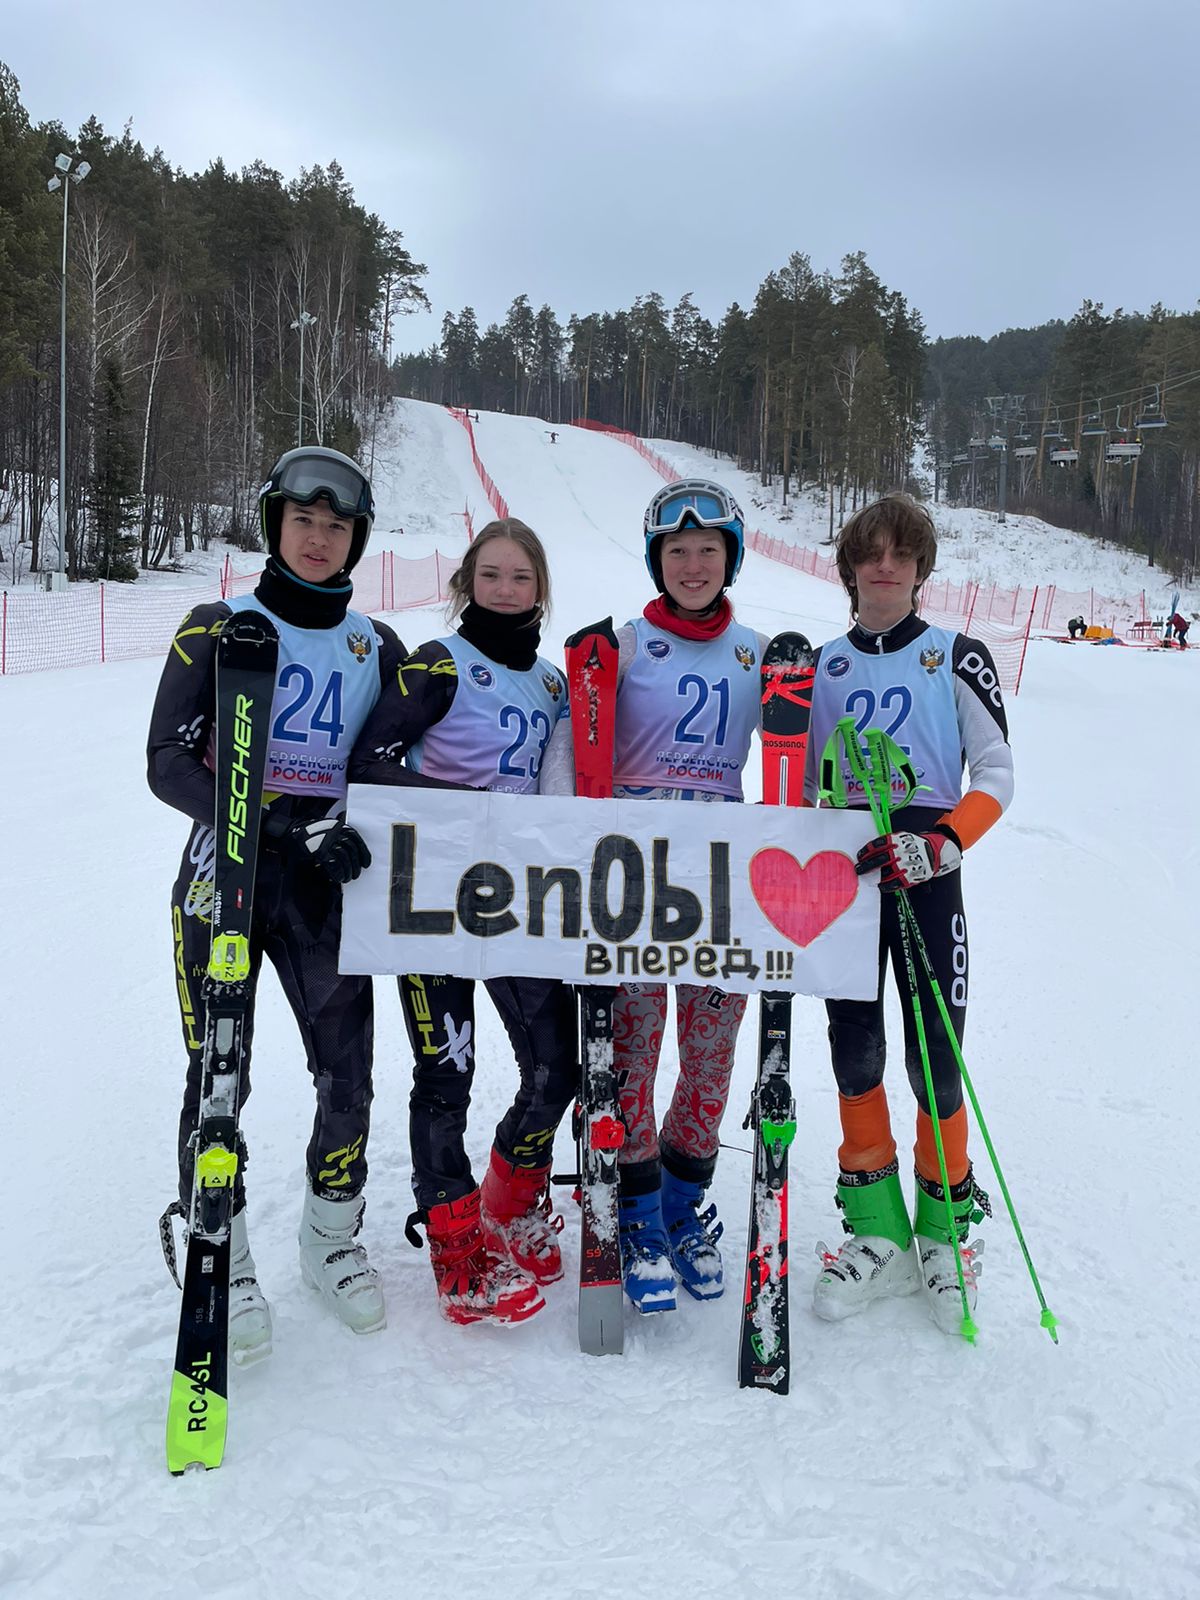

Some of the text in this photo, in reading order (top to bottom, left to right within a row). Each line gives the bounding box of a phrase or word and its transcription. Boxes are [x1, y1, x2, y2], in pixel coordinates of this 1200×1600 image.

[272, 663, 345, 747] 24
[674, 673, 730, 747] 21
[957, 652, 1003, 708] POC
[499, 704, 550, 779] 23
[763, 740, 806, 749] ROSSIGNOL
[845, 684, 912, 757] 22
[227, 694, 253, 864] FISCHER
[269, 751, 345, 770] ЕРВЕНСТВО
[272, 765, 333, 784] РОССИИ
[656, 751, 739, 770] ПЕРВЕНСТВО
[667, 764, 724, 781] РОССИИ
[408, 973, 438, 1054] HEA
